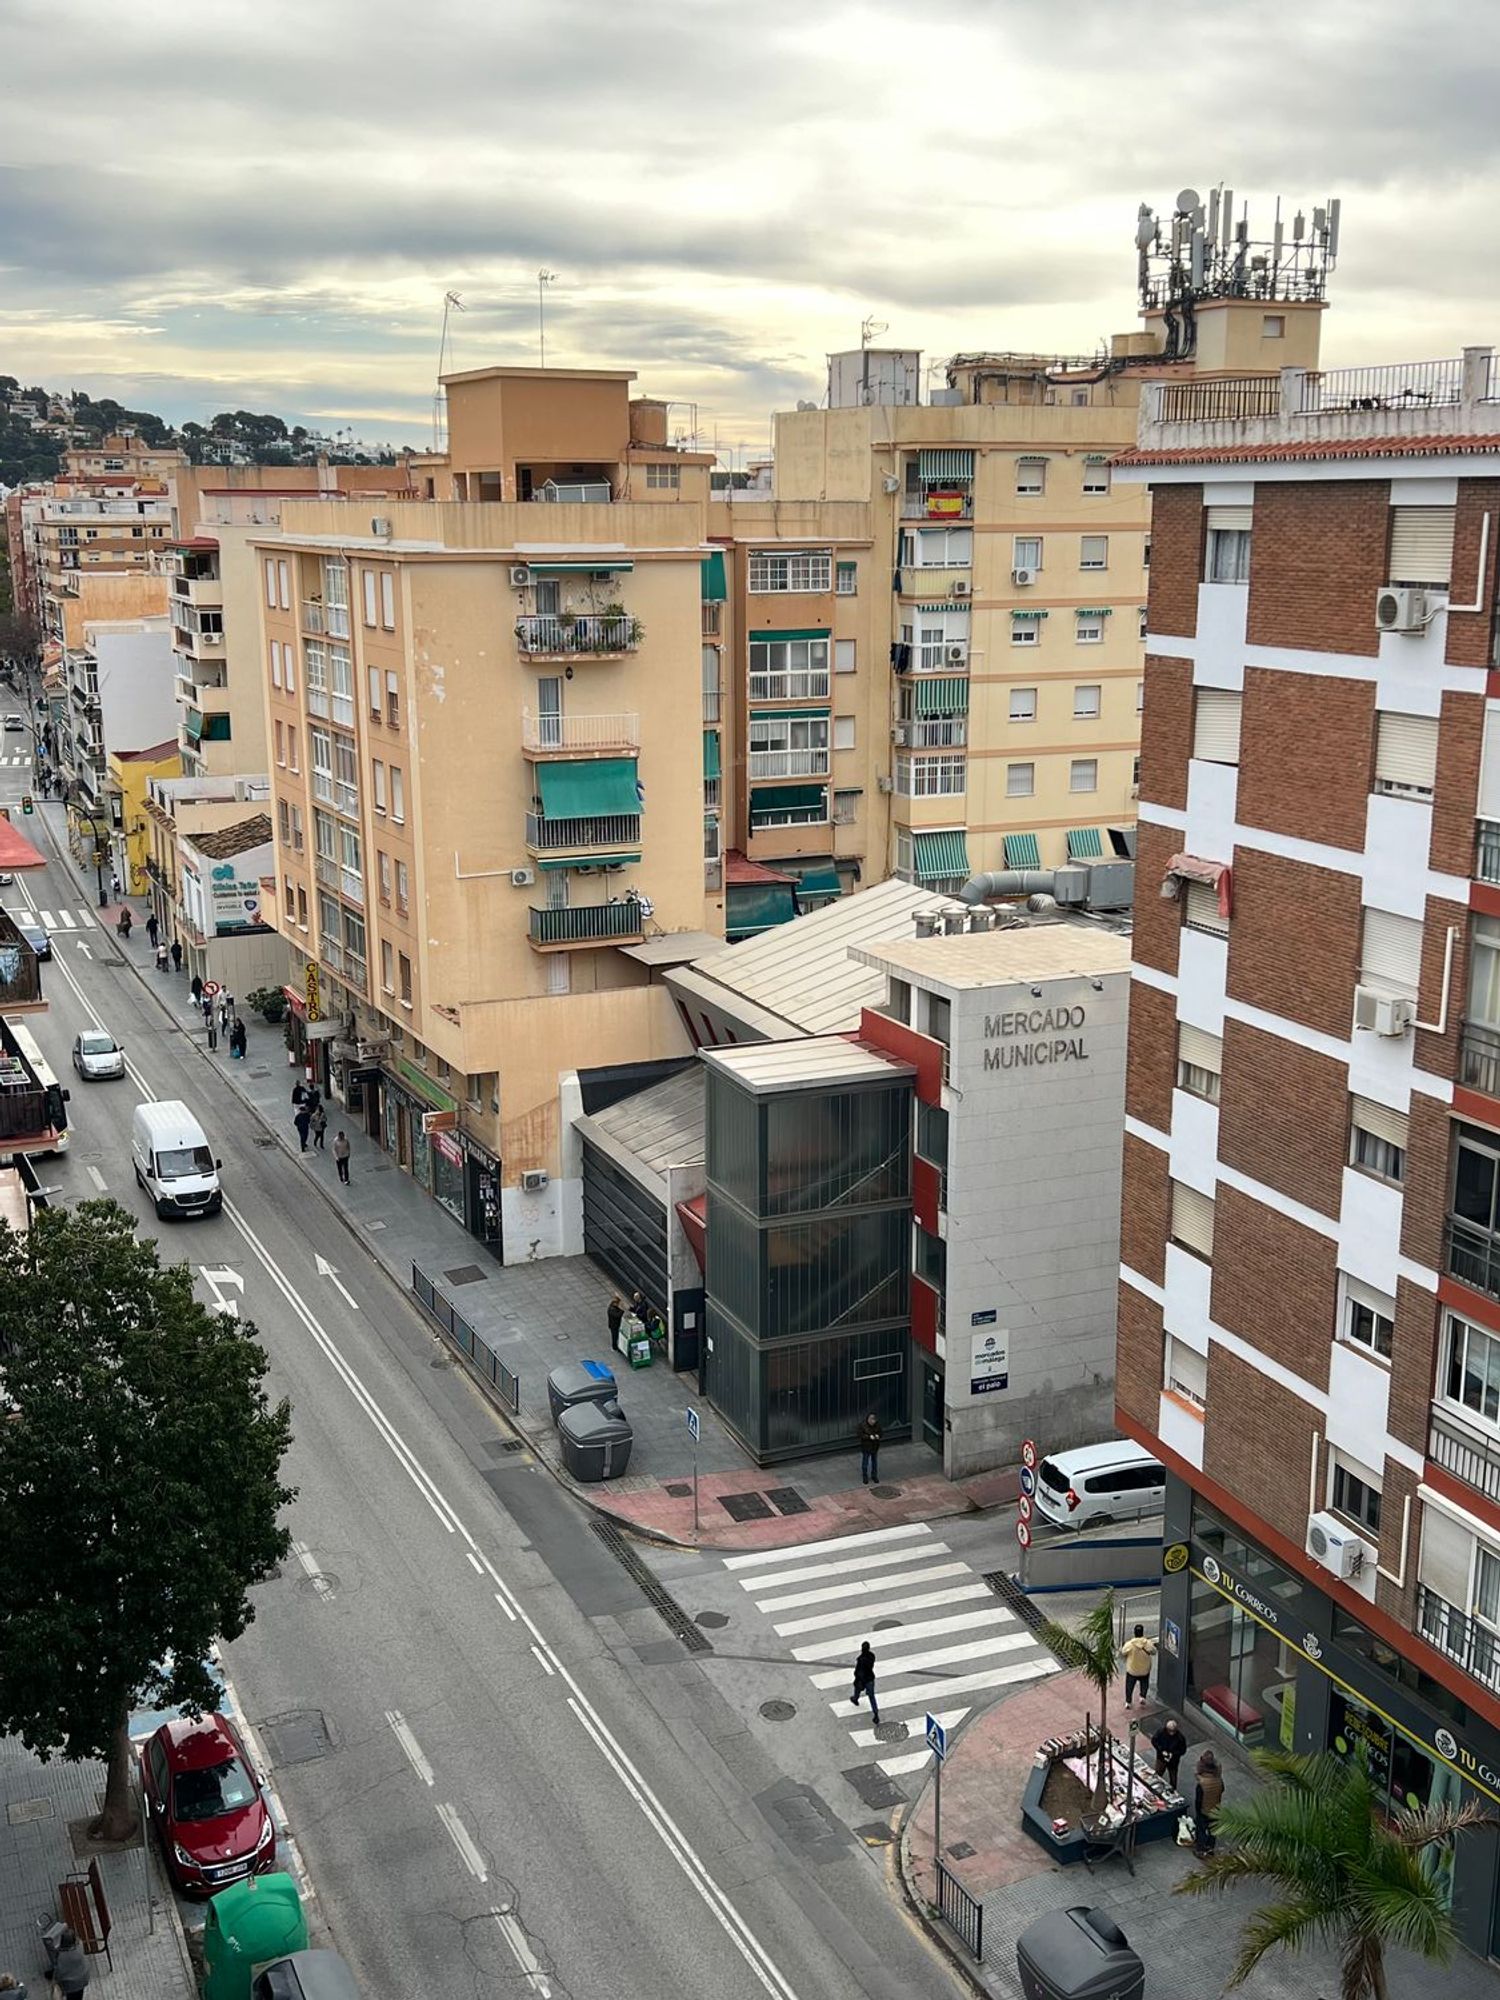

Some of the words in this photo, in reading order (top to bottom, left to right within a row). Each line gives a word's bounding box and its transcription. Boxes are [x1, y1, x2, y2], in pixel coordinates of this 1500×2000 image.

[306, 962, 319, 1021] CASTRO
[983, 1005, 1086, 1040] MERCADO
[983, 1037, 1089, 1072] MUNICIPAL
[1221, 1571, 1235, 1591] TU
[1235, 1583, 1278, 1623] CORREOS
[1459, 1747, 1476, 1771] TU
